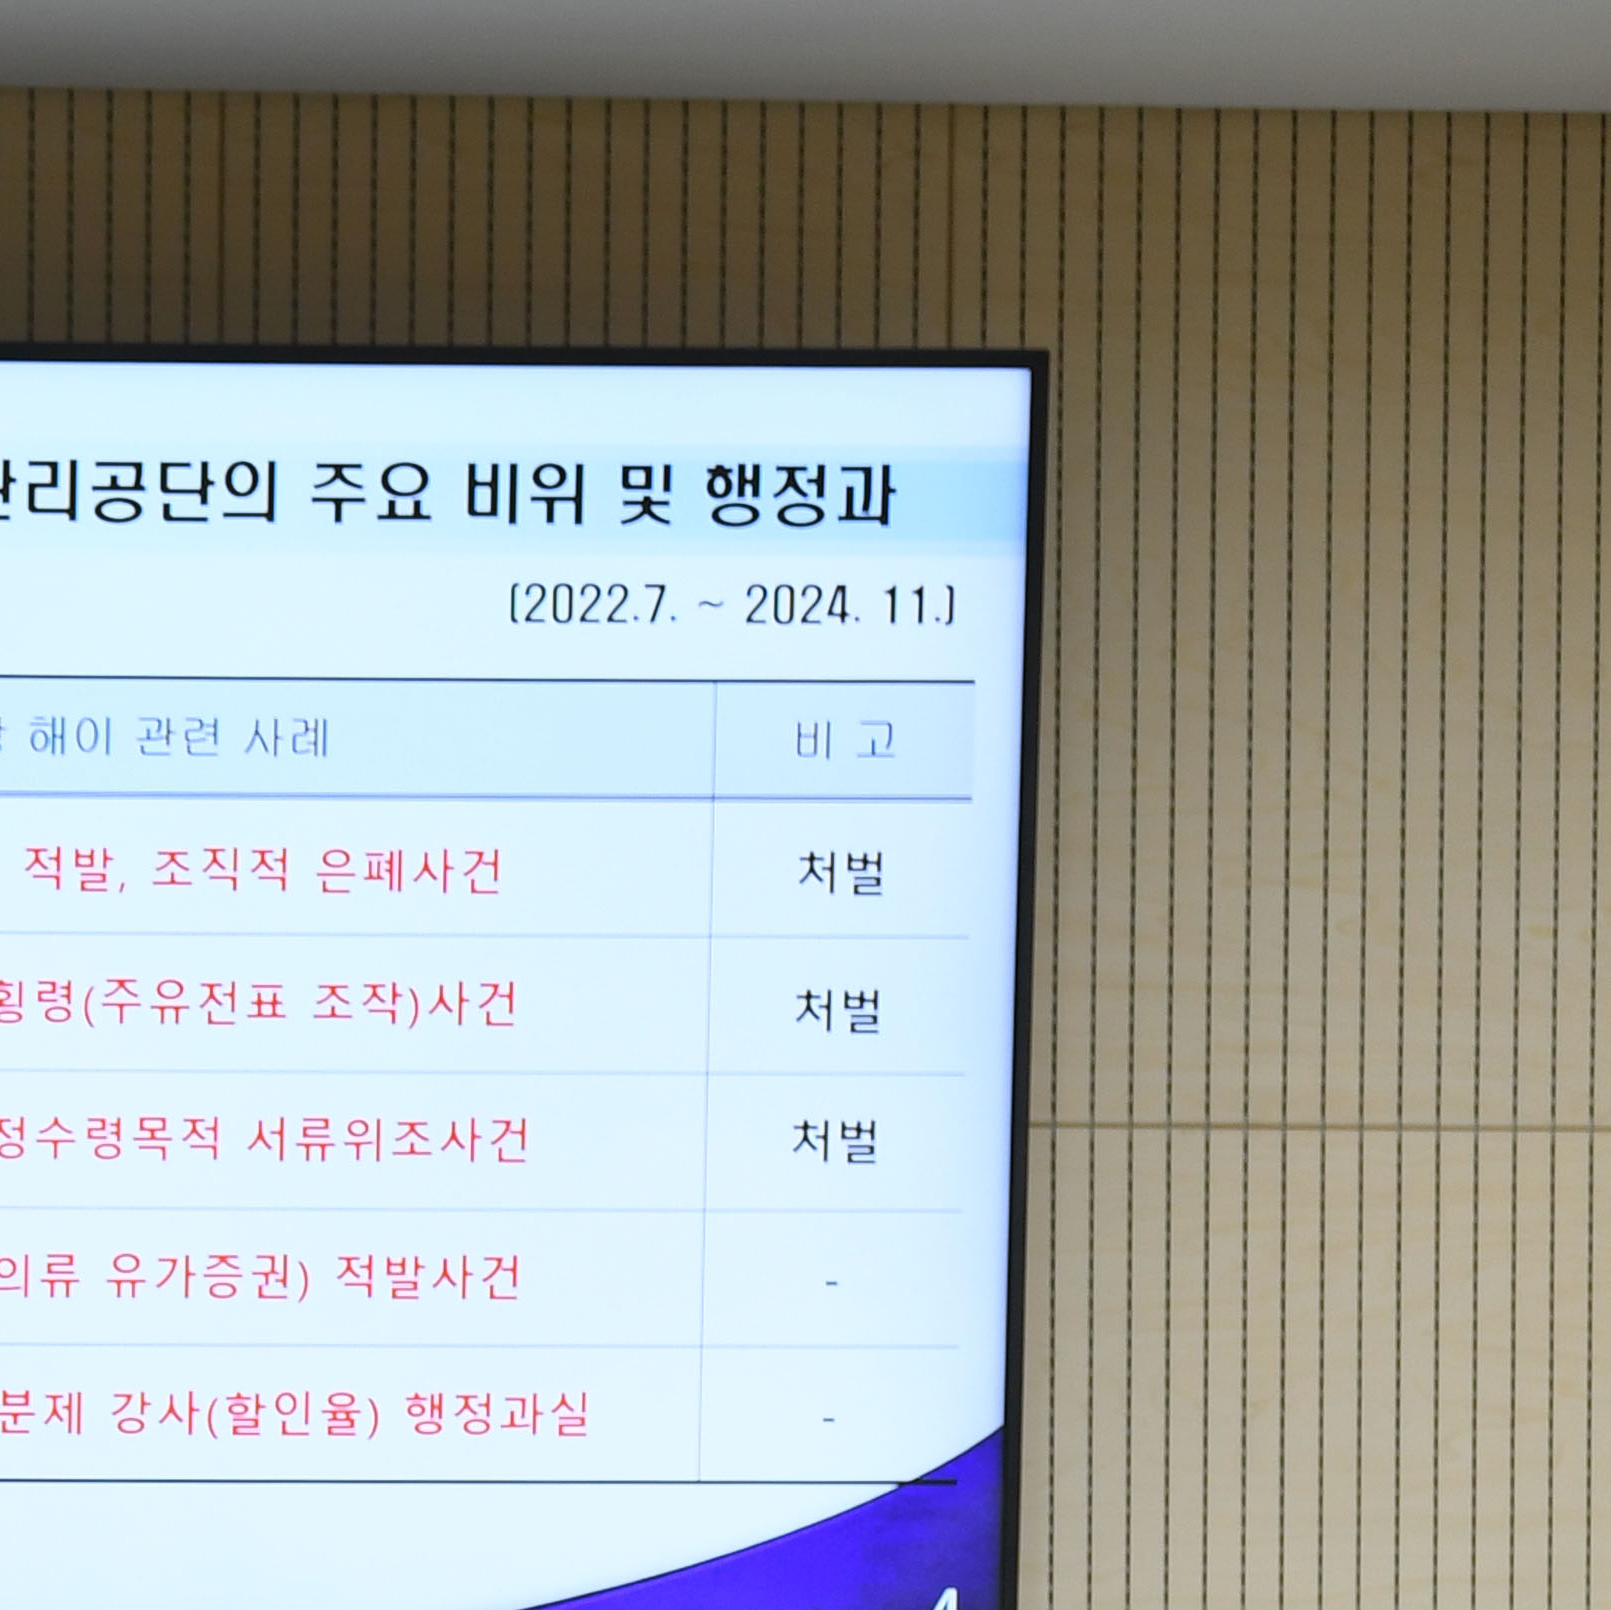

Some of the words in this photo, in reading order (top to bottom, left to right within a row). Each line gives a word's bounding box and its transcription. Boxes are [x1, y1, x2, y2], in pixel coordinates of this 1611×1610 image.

[311, 461, 432, 524] 주요
[467, 462, 585, 525] 비위
[620, 463, 672, 525] 및
[706, 463, 897, 528] 행정과
[745, 583, 860, 625] 2024.
[29, 716, 111, 756] 해이
[137, 717, 219, 757] 관련
[245, 718, 328, 758] 사례
[796, 720, 831, 761] 비
[858, 721, 893, 758] 고
[25, 845, 126, 893] 적발,
[152, 847, 287, 892] 조직적
[316, 848, 499, 895] 은폐사건
[799, 851, 882, 896] 처벌
[313, 980, 514, 1029] 조작)사건
[796, 989, 879, 1034] 처벌
[247, 1116, 527, 1164] 서류위조사건
[793, 1119, 876, 1164] 처벌
[106, 1253, 309, 1303] 유가증권)
[336, 1254, 518, 1300] 적발사건
[111, 1390, 379, 1440] 강사(할인율)
[405, 1391, 587, 1437] 행정과실
